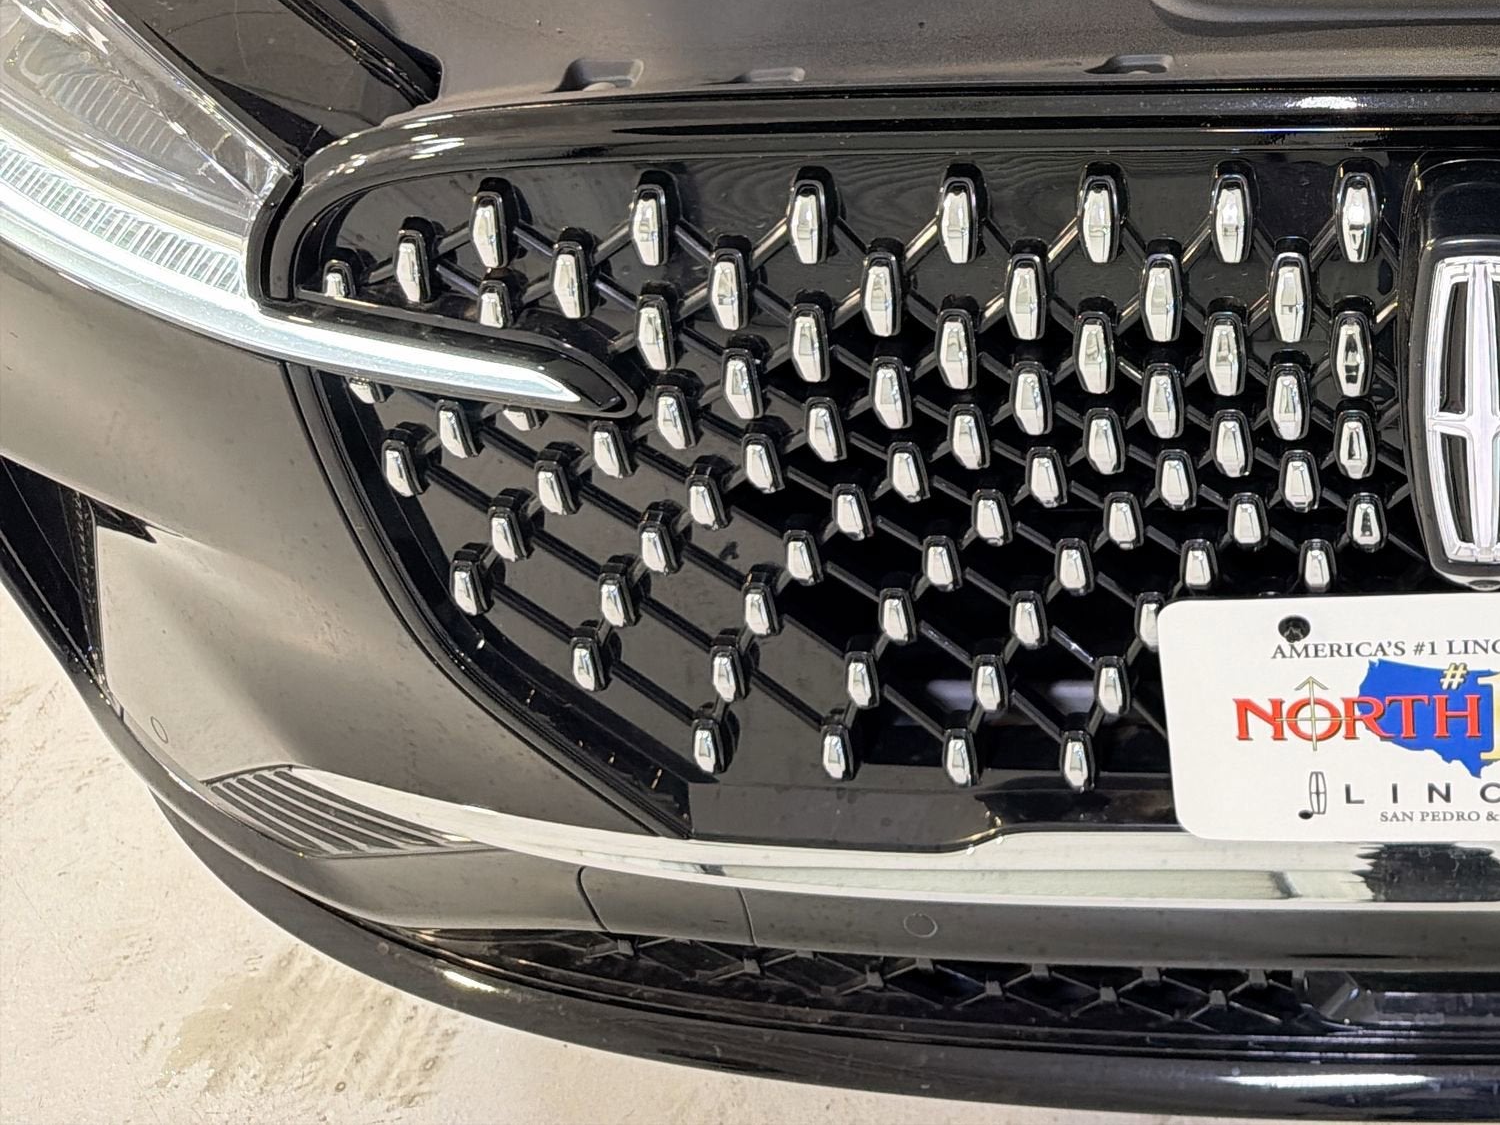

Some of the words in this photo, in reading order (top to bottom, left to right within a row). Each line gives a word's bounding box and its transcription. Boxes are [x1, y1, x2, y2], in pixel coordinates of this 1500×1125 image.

[1271, 641, 1406, 659] AMERICA'S
[1413, 641, 1438, 656] #1
[1234, 695, 1482, 742] NORTH
[1380, 811, 1414, 822] SAN
[1420, 811, 1481, 822] PEDRO
[1486, 812, 1499, 822] &
